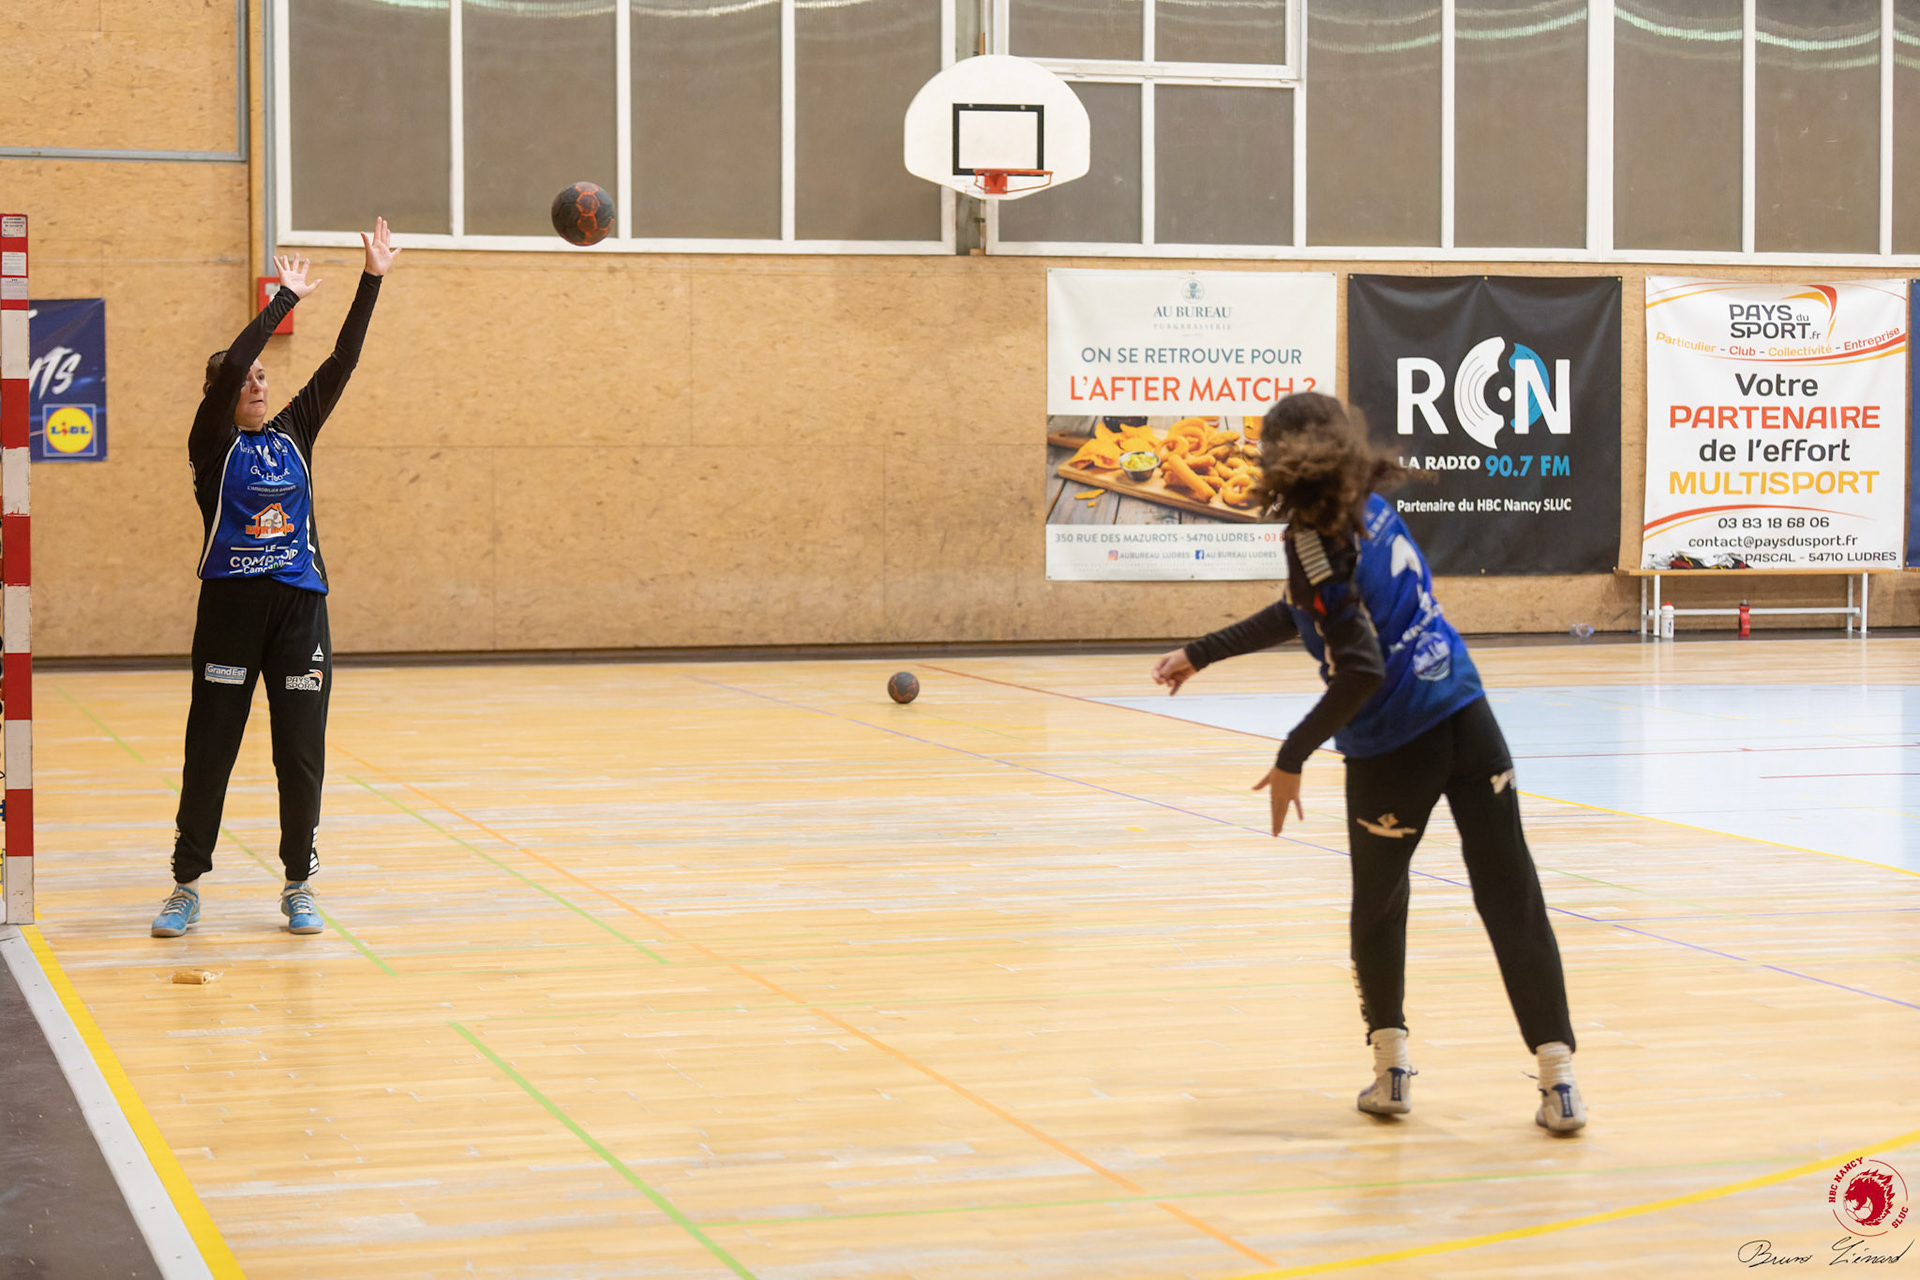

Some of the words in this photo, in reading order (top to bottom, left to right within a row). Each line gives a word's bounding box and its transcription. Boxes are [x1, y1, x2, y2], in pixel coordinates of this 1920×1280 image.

[1153, 306, 1173, 318] AU
[1176, 306, 1232, 318] BUREAU
[1729, 304, 1792, 321] PAYS
[1796, 313, 1809, 321] du
[1655, 331, 1717, 353] Particulier
[1729, 345, 1756, 356] Club
[1768, 344, 1832, 357] Collectivité
[1844, 327, 1900, 351] Entreprise
[1081, 347, 1111, 363] ON
[1117, 348, 1139, 363] SE
[1145, 348, 1245, 364] RETROUVE
[1251, 349, 1302, 364] POUR
[1070, 376, 1180, 401] L'AFTER
[1189, 377, 1293, 402] MATCH
[1396, 336, 1571, 450] RCN
[1735, 373, 1819, 397] Votre
[1670, 405, 1881, 429] PARTENAIRE
[1699, 439, 1736, 462] de
[1748, 438, 1850, 462] l'effort
[1425, 456, 1481, 470] RADIO
[1485, 455, 1533, 477] 90.7
[1541, 455, 1570, 477] FM
[1669, 471, 1880, 495] MULTISPORT
[1396, 499, 1455, 512] Partenaire
[1458, 499, 1474, 512] du
[1477, 499, 1501, 512] HBC
[1504, 499, 1541, 513] Nancy
[1543, 498, 1572, 511] SLUC
[1717, 517, 1737, 529] 03
[1742, 517, 1762, 528] 83
[1768, 517, 1782, 528] 18
[1786, 517, 1805, 528] 68
[1809, 517, 1830, 528] 06
[1055, 533, 1074, 543] 350
[1076, 533, 1098, 543] RUE
[1100, 533, 1121, 543] DES
[1123, 533, 1178, 543] MAZUROTS
[1186, 533, 1213, 542] 54710
[1215, 533, 1255, 542] LUDRES
[1264, 533, 1276, 542] 03
[1688, 534, 1858, 549] contact@paysdusport.fr
[265, 544, 276, 553] LE
[1206, 551, 1216, 559] AU
[1218, 551, 1247, 559] BUREAU
[1248, 551, 1277, 559] LUDRES
[1745, 552, 1796, 563] PASCAL
[1808, 552, 1844, 562] 54710
[1847, 551, 1897, 562] LUDRES
[207, 665, 232, 675] Grand
[232, 668, 245, 677] Est
